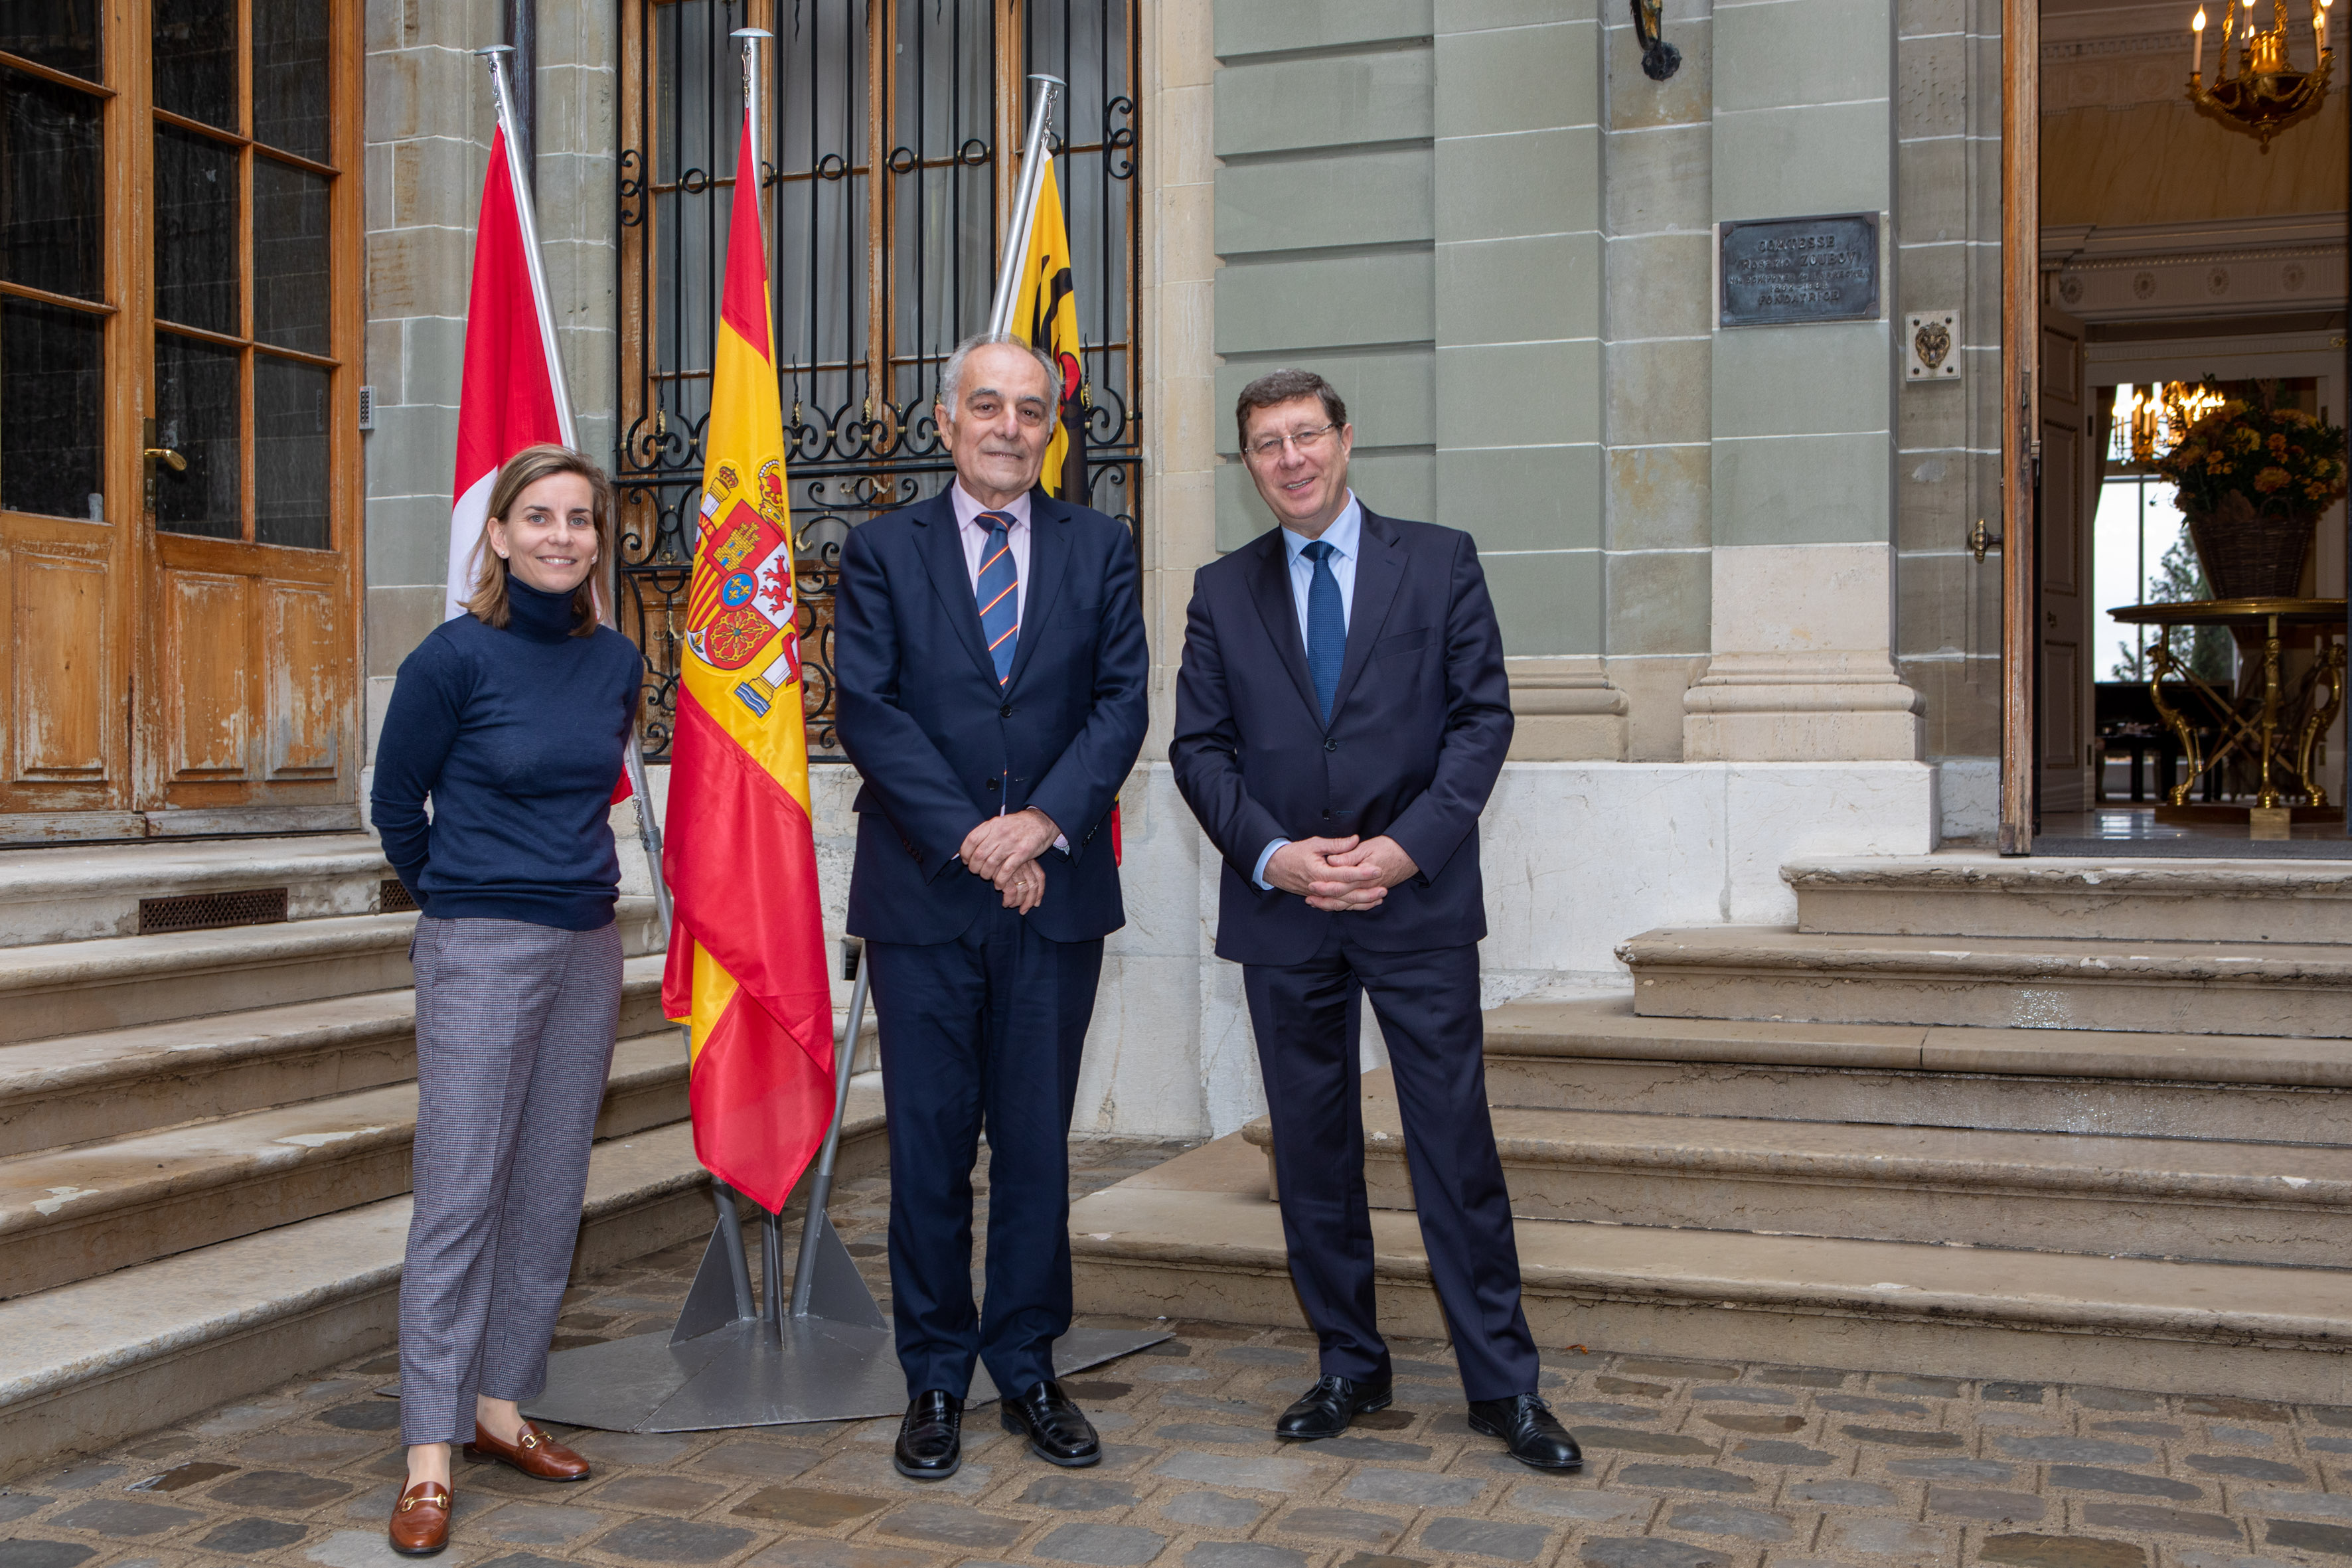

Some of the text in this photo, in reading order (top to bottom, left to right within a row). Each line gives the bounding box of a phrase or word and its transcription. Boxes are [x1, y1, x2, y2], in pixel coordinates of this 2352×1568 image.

[1758, 235, 1835, 252] COMTESSE
[1800, 252, 1856, 266] ZOUBOV
[1758, 291, 1838, 305] FONDATRICE
[698, 514, 714, 536] LVS
